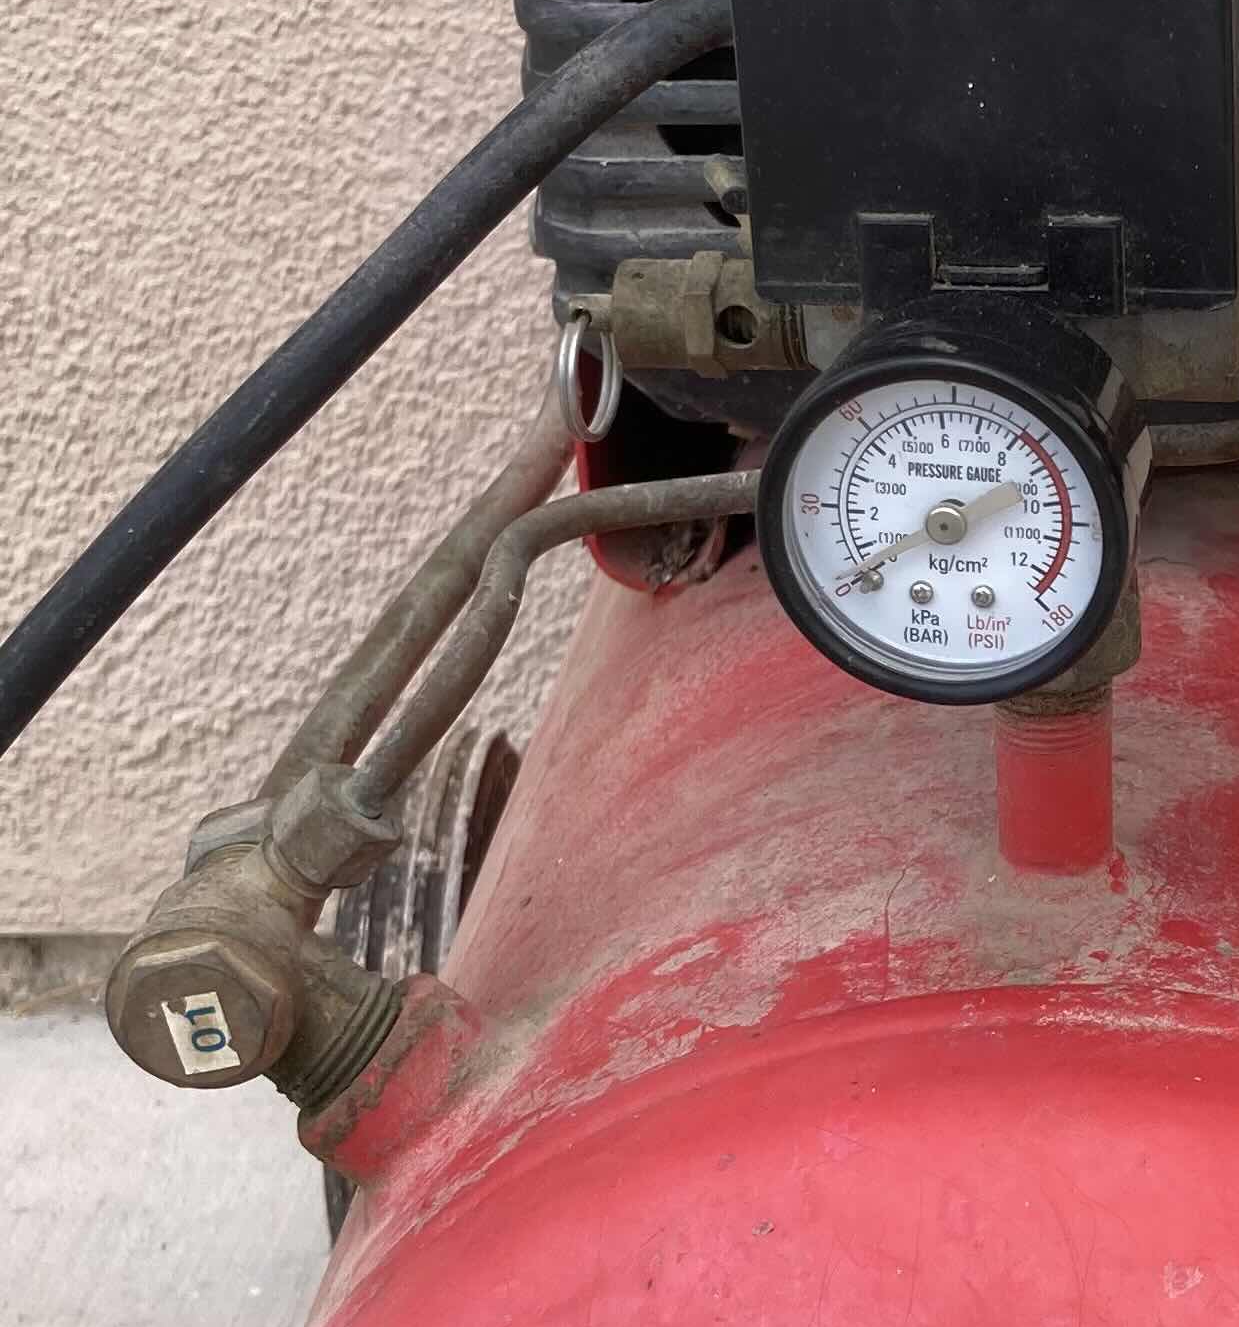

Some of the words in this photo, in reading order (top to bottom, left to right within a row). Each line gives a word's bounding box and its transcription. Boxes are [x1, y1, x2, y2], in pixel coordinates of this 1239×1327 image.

[839, 400, 863, 422] 60
[902, 440, 934, 455] (5)00
[940, 433, 950, 449] 6
[958, 439, 991, 454] (7)00
[888, 454, 897, 469] 4
[997, 451, 1007, 467] 8
[908, 461, 963, 481] PRESSURE
[966, 465, 1002, 484] GAUGE
[875, 482, 907, 496] (3)00
[800, 492, 820, 516] 30
[1023, 499, 1040, 515] 10
[869, 506, 879, 521] 2
[1009, 551, 1029, 567] 12
[835, 582, 852, 597] 0
[911, 608, 940, 626] kPa
[1041, 603, 1075, 633] 180
[903, 627, 949, 646] (BAR)
[968, 633, 1005, 651] (PSI)
